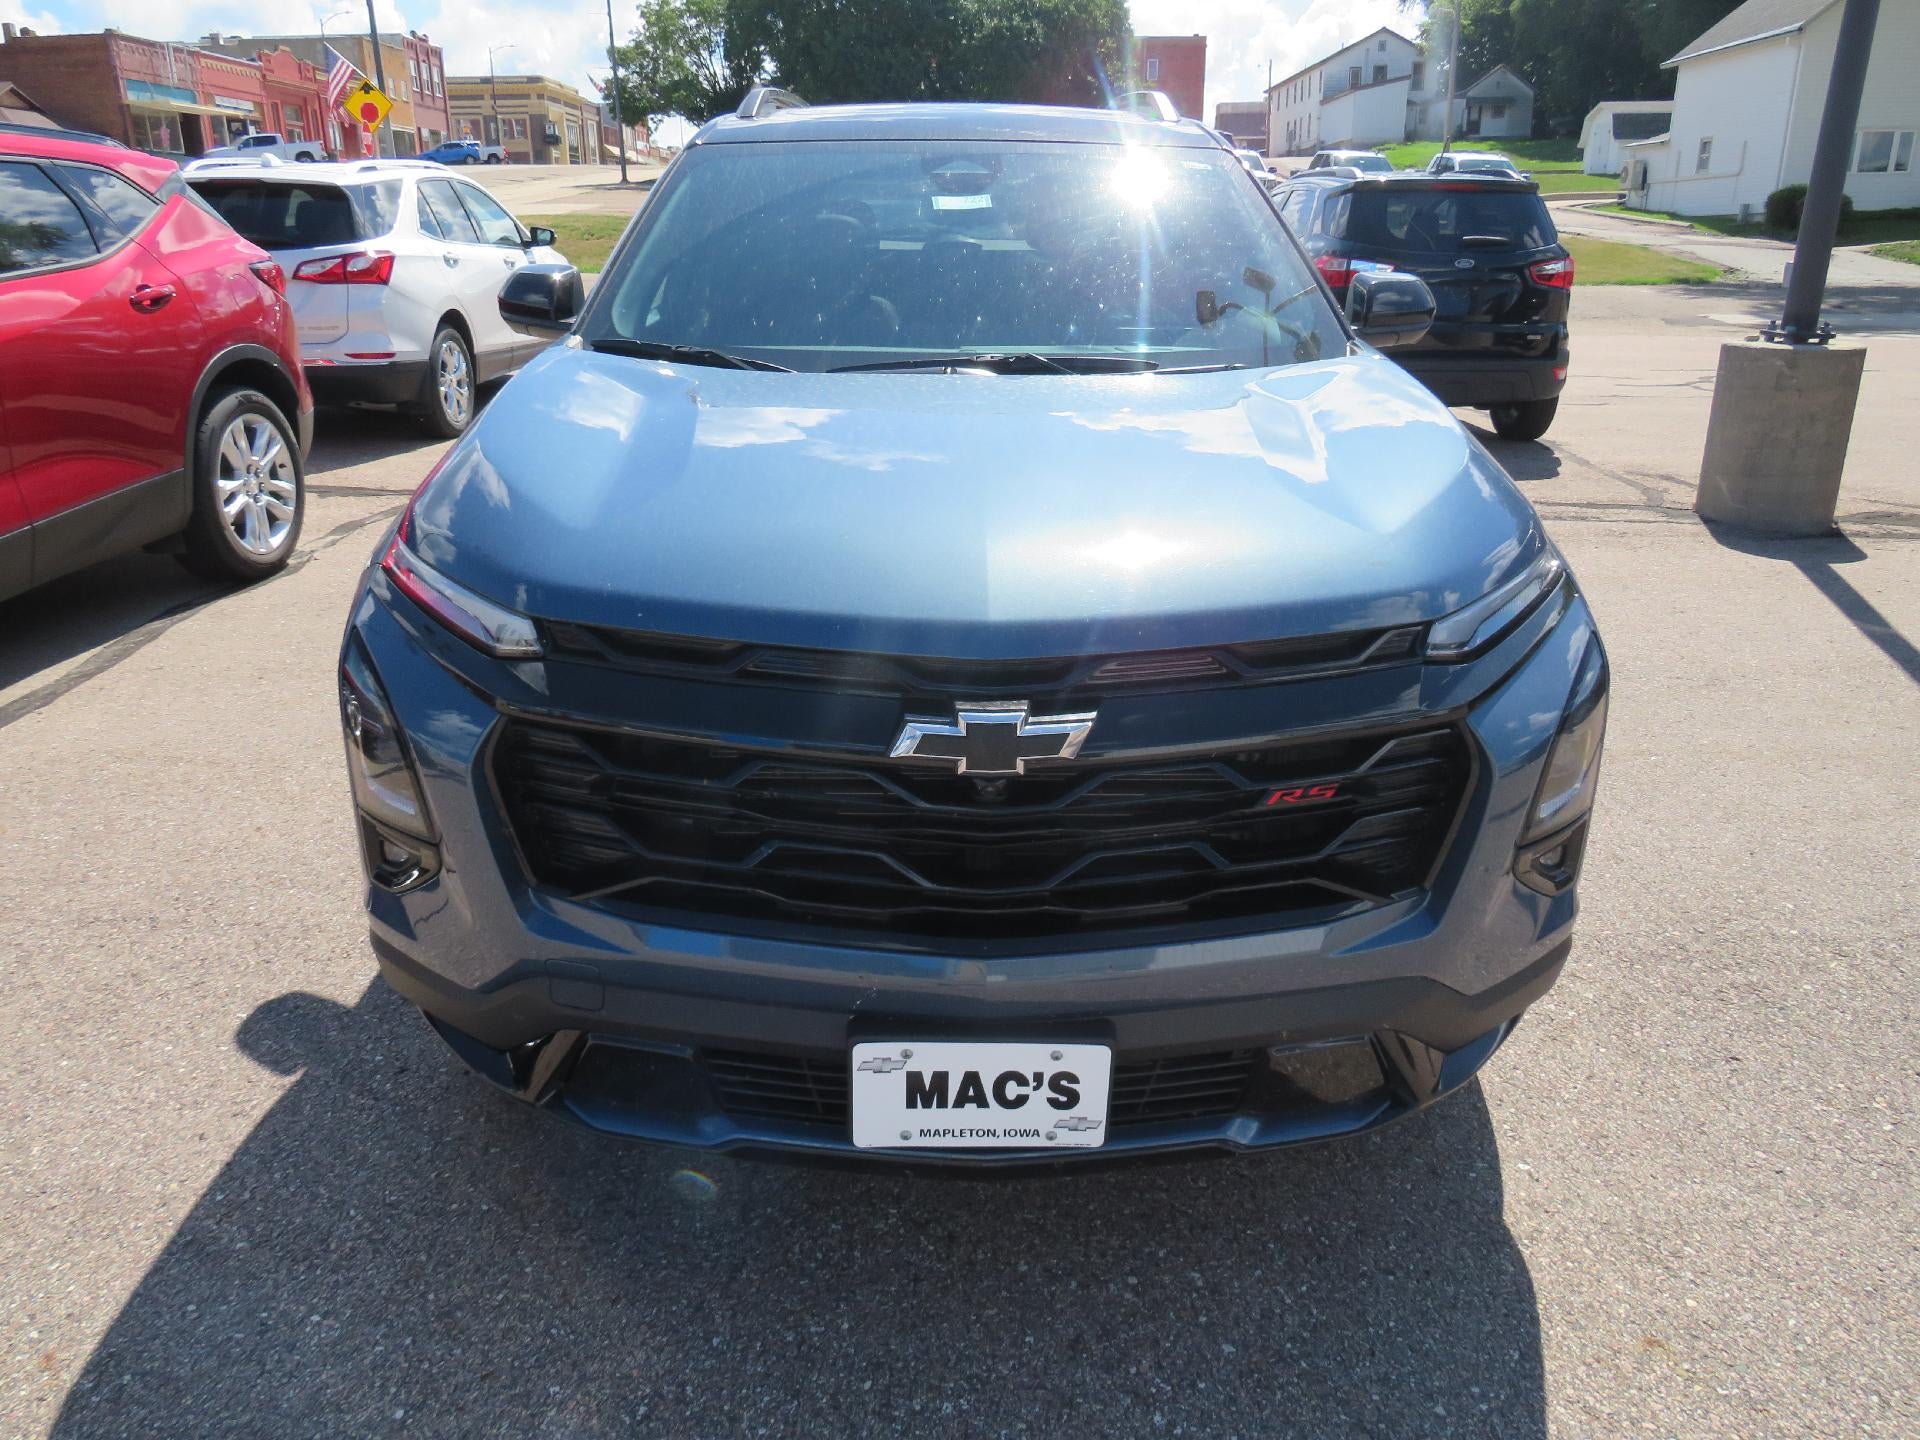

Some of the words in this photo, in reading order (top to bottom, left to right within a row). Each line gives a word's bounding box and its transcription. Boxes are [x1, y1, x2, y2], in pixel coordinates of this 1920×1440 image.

[1266, 783, 1340, 805] RS
[905, 1070, 1081, 1110] MAC'S
[919, 1128, 1000, 1139] MAPLETON,
[1003, 1128, 1041, 1138] IOWA
